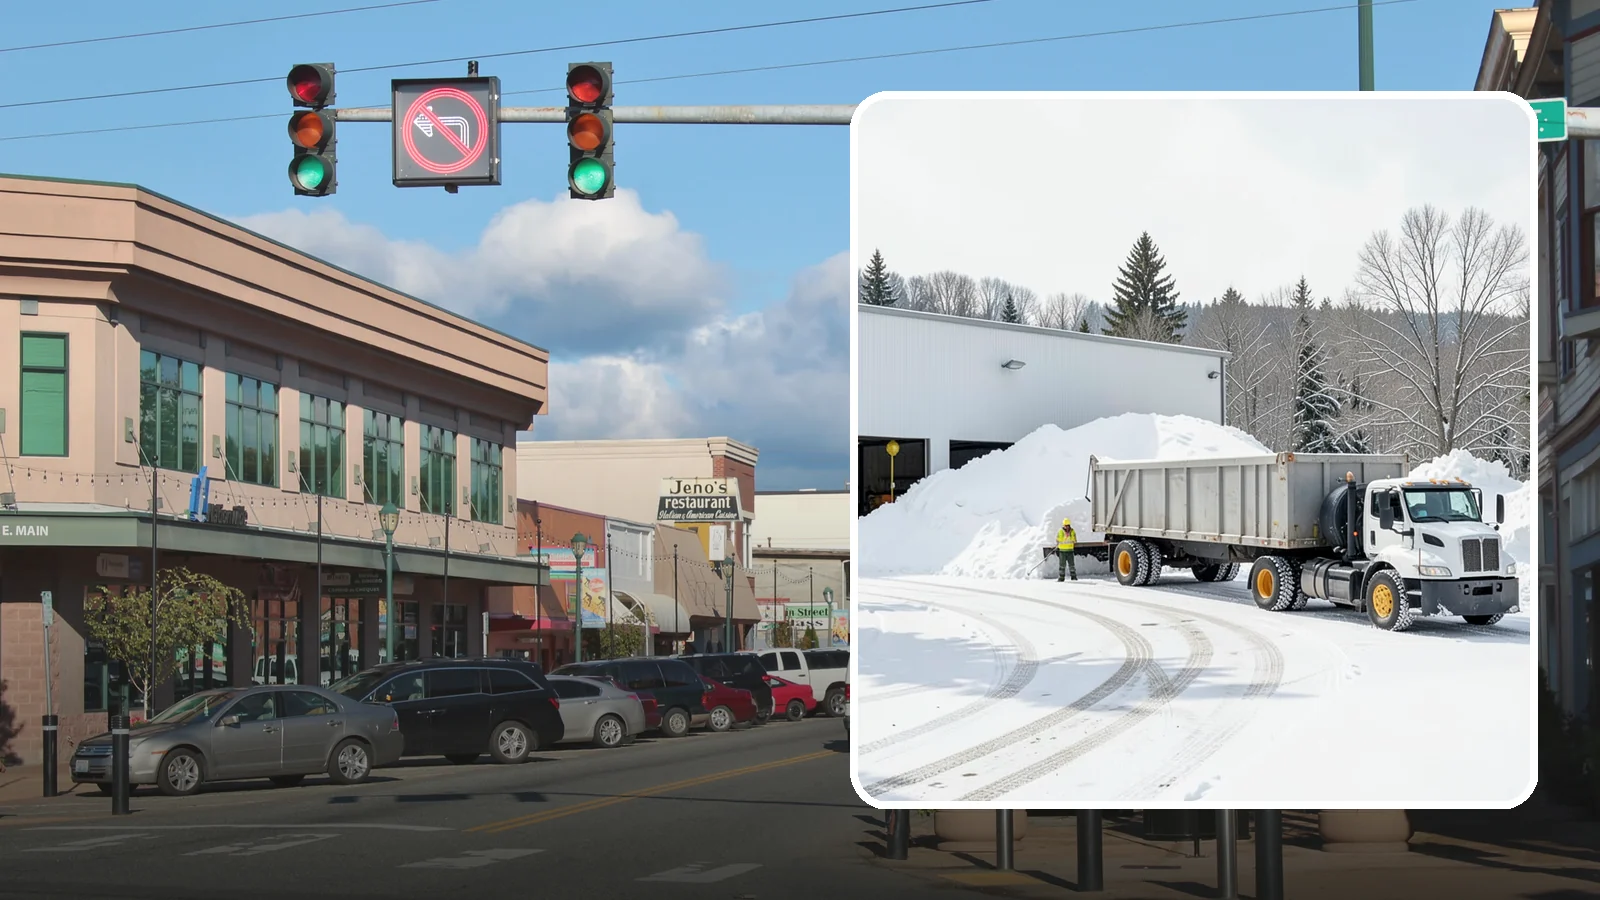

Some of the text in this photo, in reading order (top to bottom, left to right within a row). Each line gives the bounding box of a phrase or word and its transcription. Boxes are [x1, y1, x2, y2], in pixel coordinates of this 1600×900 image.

[670, 480, 727, 494] Jeno's
[665, 496, 731, 509] restaurant
[658, 510, 682, 519] Italian
[686, 510, 714, 519] American
[715, 510, 737, 519] Cuisine
[2, 525, 49, 536] E. MAIN
[785, 607, 828, 616] in Street
[790, 619, 823, 627] lass
